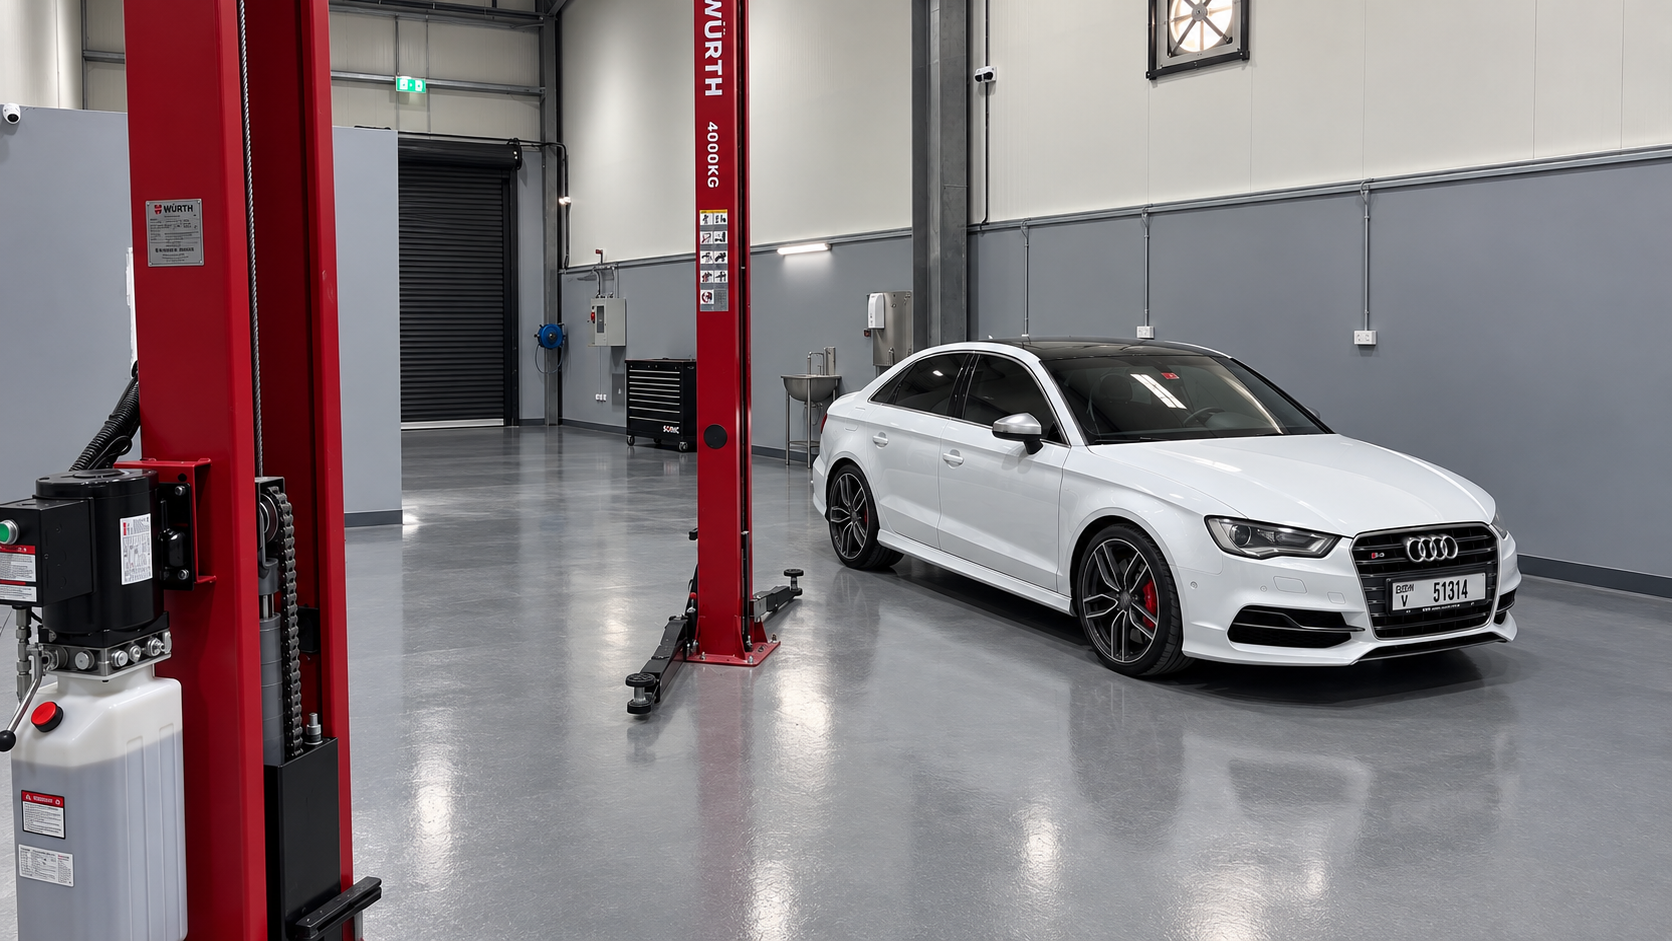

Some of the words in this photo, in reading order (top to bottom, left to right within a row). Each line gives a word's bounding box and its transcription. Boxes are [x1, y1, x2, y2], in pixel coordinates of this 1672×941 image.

[704, 0, 726, 96] WÜRTH
[707, 121, 719, 188] 4000KG
[163, 203, 193, 213] WÜRTH
[1401, 594, 1408, 607] V
[1433, 579, 1468, 602] 51314
